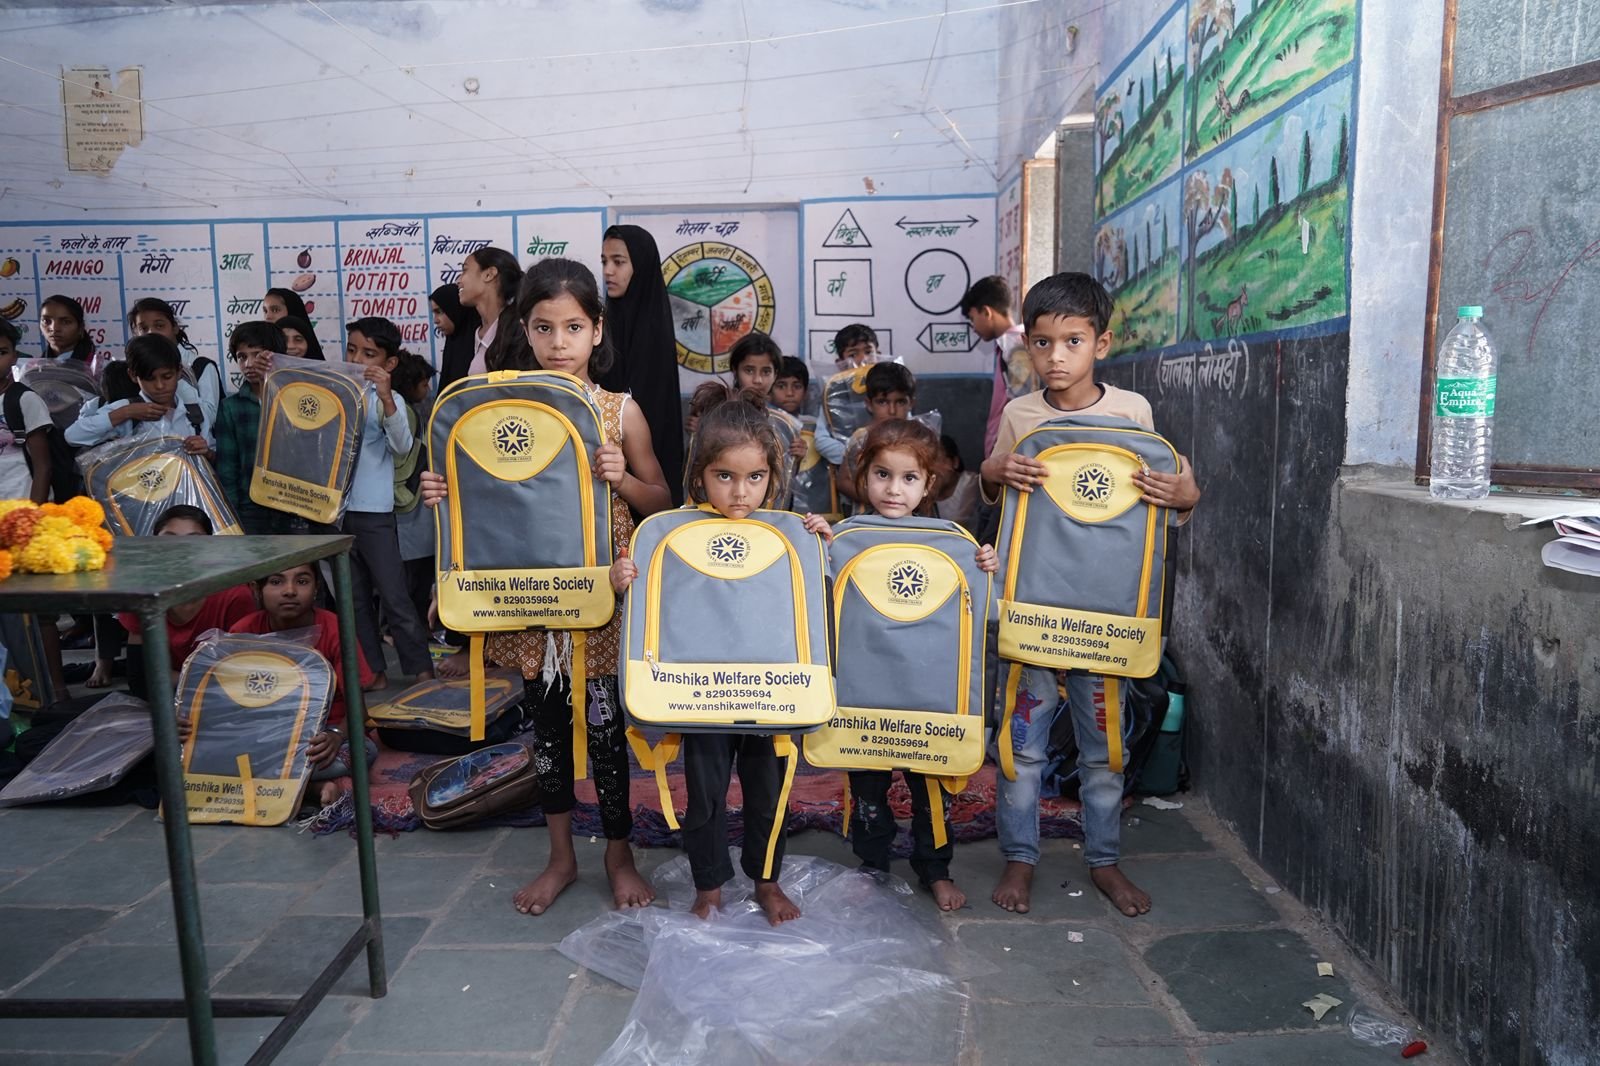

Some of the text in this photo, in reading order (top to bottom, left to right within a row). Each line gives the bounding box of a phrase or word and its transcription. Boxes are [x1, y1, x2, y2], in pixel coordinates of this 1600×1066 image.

[88, 234, 101, 249] के
[102, 236, 132, 250] नाम
[344, 246, 406, 267] BRINJAL
[45, 259, 104, 276] MANGO
[346, 272, 410, 292] POTATO
[351, 297, 418, 317] TOMATO
[1450, 389, 1478, 399] Aqua
[457, 576, 594, 593] Vanshika Welfare Society
[503, 595, 559, 605] 8290359694
[472, 608, 580, 618] www.vanshikawelfare.org
[1007, 609, 1146, 644] Vanshika Welfare Society
[1052, 634, 1110, 649] 8290359694
[1019, 642, 1128, 667] www.vanshikawelfare.org
[651, 668, 811, 688] Vanshika Welfare Society
[705, 689, 772, 699] 8290359694
[668, 701, 796, 713] www.vanshikawelfare.org
[879, 717, 922, 735] Welfare
[925, 721, 966, 742] Society
[871, 735, 929, 749] 8290359694
[839, 747, 948, 765] www.vanshikawelfare.org
[256, 785, 284, 799] Society
